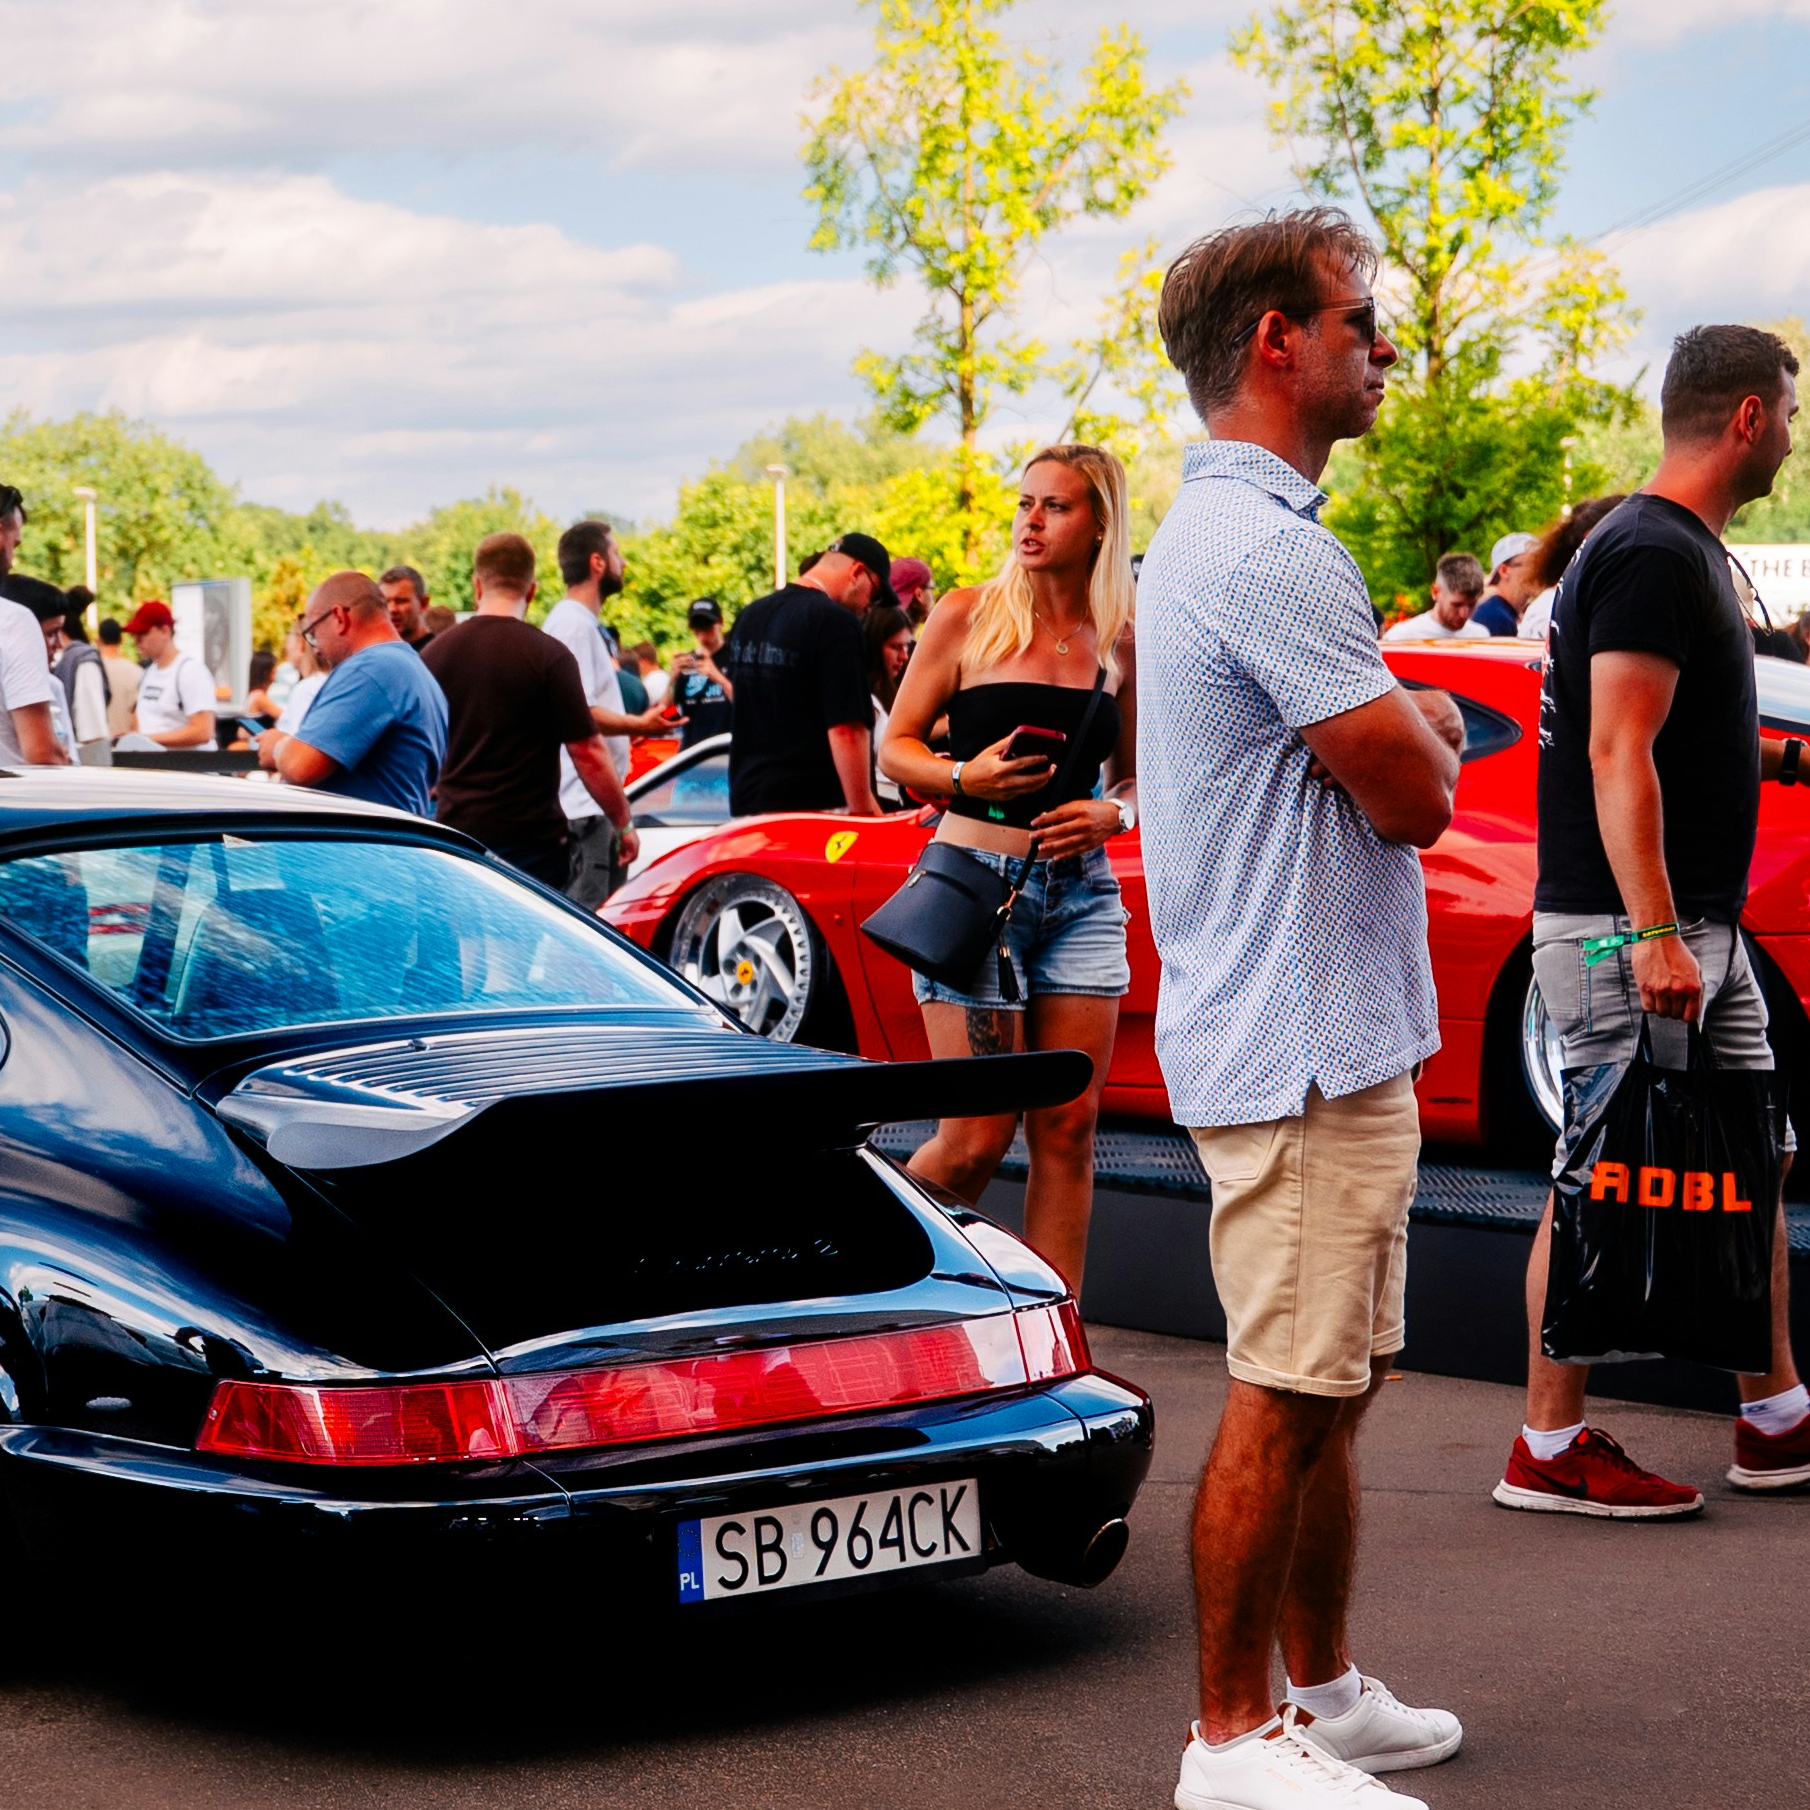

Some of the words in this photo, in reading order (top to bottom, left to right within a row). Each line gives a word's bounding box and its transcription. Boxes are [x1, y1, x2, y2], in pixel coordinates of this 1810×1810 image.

[1751, 559, 1792, 578] THE
[1590, 1160, 1753, 1213] ADBL
[715, 1515, 788, 1591] SB
[810, 1484, 971, 1578] 964CK
[680, 1572, 700, 1591] PL
